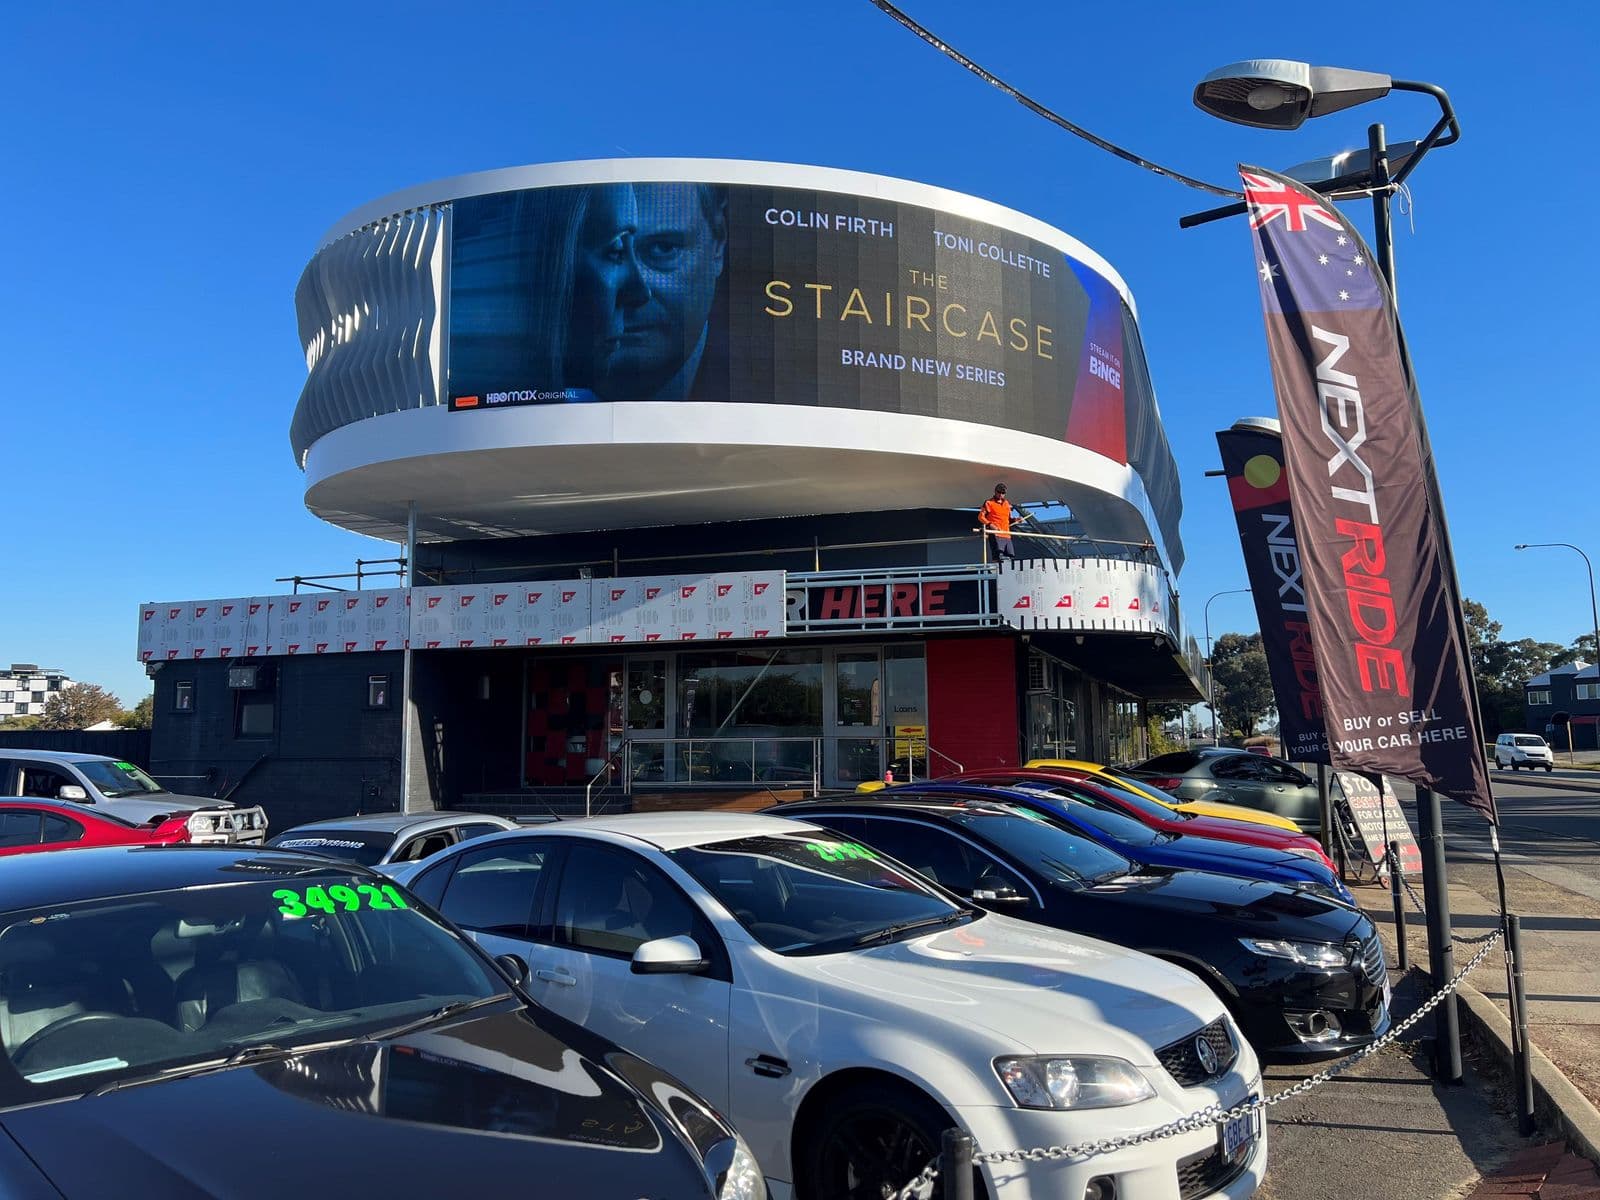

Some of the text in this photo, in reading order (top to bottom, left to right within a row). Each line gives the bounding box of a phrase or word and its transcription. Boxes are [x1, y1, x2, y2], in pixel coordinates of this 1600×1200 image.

[764, 207, 894, 238] COLIN FIRTH
[933, 230, 1051, 279] TONI COLLETTE
[908, 269, 949, 290] THE
[764, 280, 1054, 361] STAIRCASE
[841, 348, 1006, 388] BRAND NEW SERIES
[538, 391, 579, 400] ORIGINAL
[1311, 324, 1409, 698] NEXT RIDE
[820, 581, 950, 620] HERE
[894, 705, 918, 713] Loans
[1343, 707, 1442, 731] BUY or SELL
[1291, 744, 1320, 754] YOUR
[1298, 732, 1318, 742] BUY
[1335, 736, 1374, 754] YOUR
[1377, 733, 1412, 749] CAR
[1417, 726, 1468, 745] HERE
[1356, 810, 1373, 820] FOR
[272, 884, 408, 918] 34921
